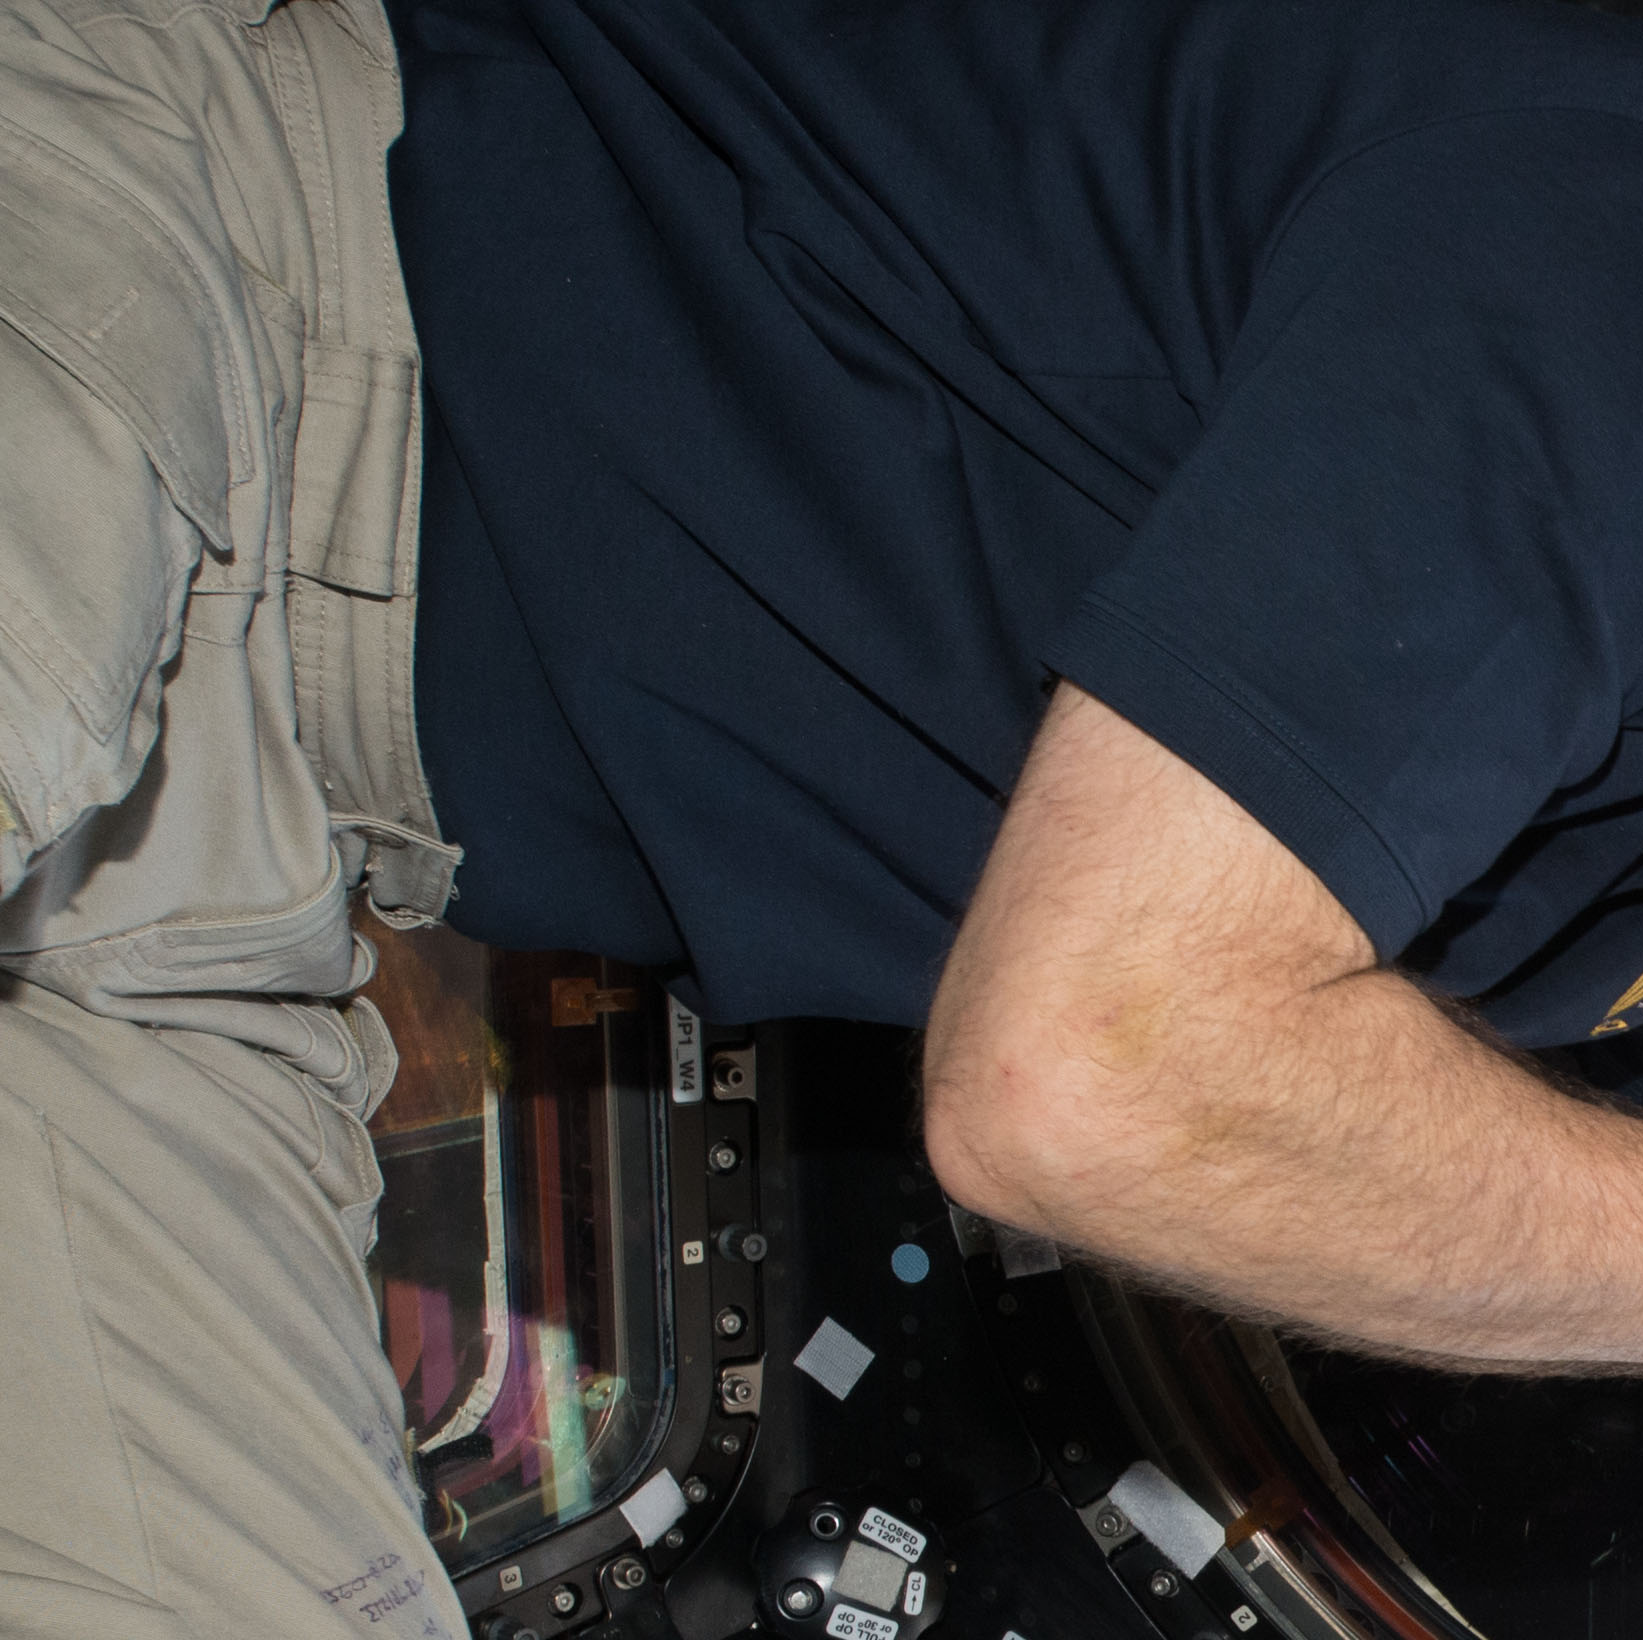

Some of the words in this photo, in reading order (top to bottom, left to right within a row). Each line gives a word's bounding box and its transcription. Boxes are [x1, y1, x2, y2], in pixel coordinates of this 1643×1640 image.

[687, 1247, 699, 1258] 2
[873, 1514, 918, 1546] CLOSED
[862, 1522, 875, 1532] or
[902, 1544, 919, 1558] OP
[505, 1573, 517, 1585] 3
[911, 1576, 922, 1592] CL
[838, 1612, 856, 1624] OP
[1238, 1612, 1251, 1626] 2
[835, 1624, 854, 1636] OP
[880, 1624, 893, 1634] or
